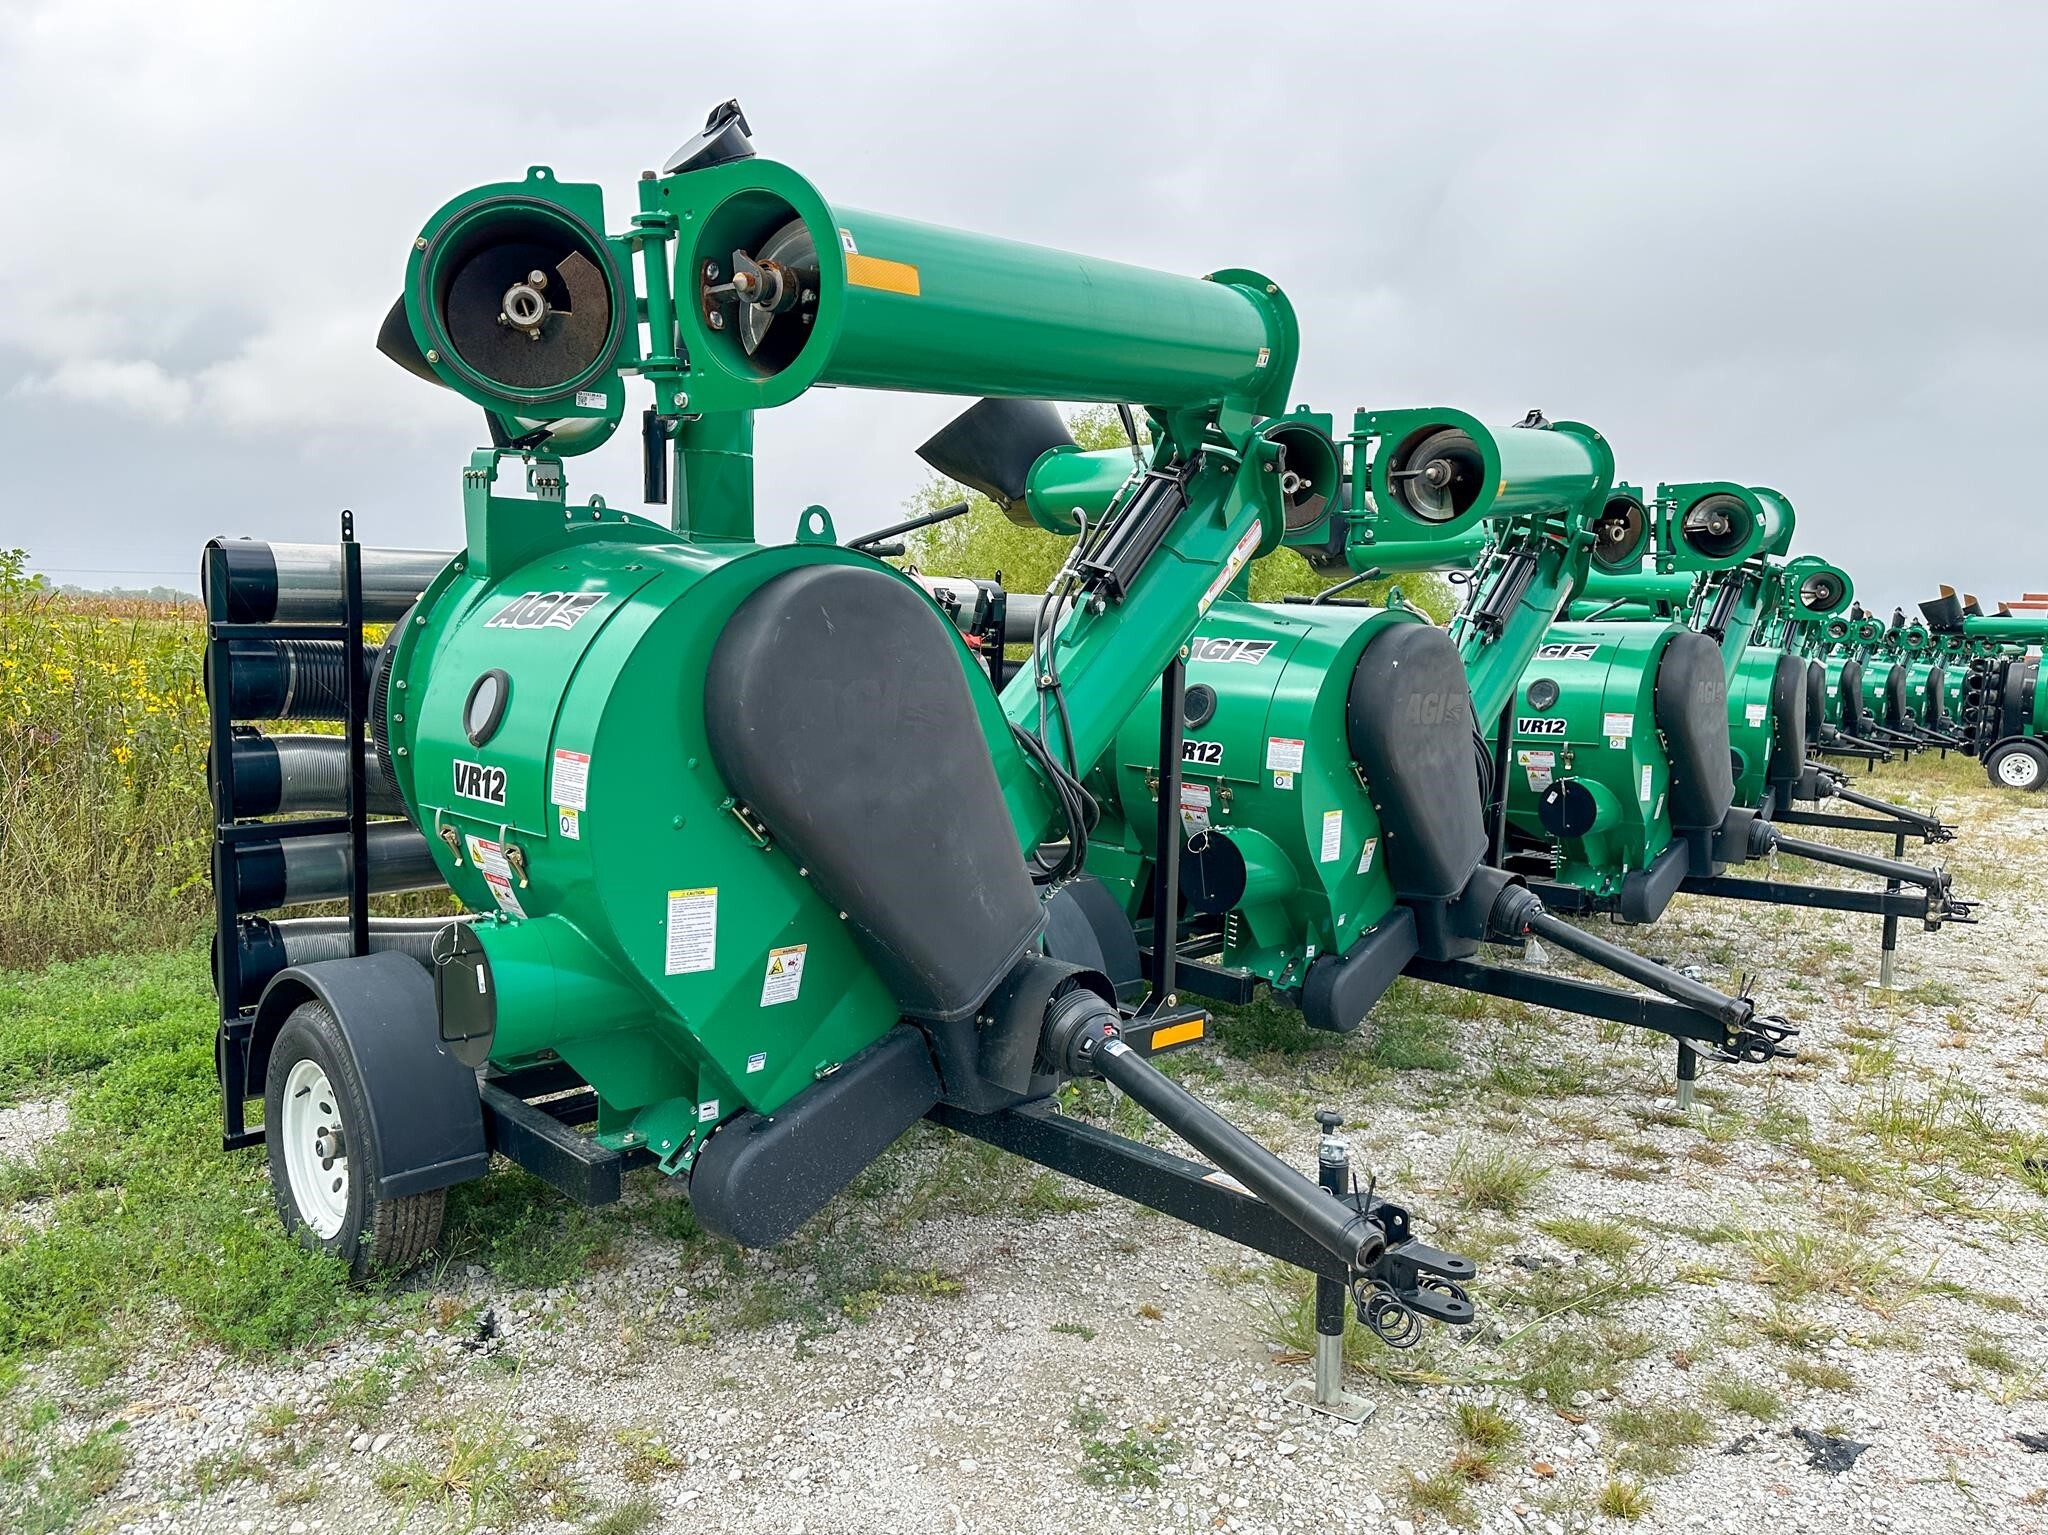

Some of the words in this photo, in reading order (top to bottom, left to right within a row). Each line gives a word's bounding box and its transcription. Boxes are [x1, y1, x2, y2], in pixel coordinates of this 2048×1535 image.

[489, 594, 576, 626] AGI
[1534, 645, 1573, 659] GI
[1407, 692, 1449, 724] AGI
[1519, 719, 1565, 733] VR12
[1182, 741, 1222, 763] R12
[455, 763, 505, 803] VR12
